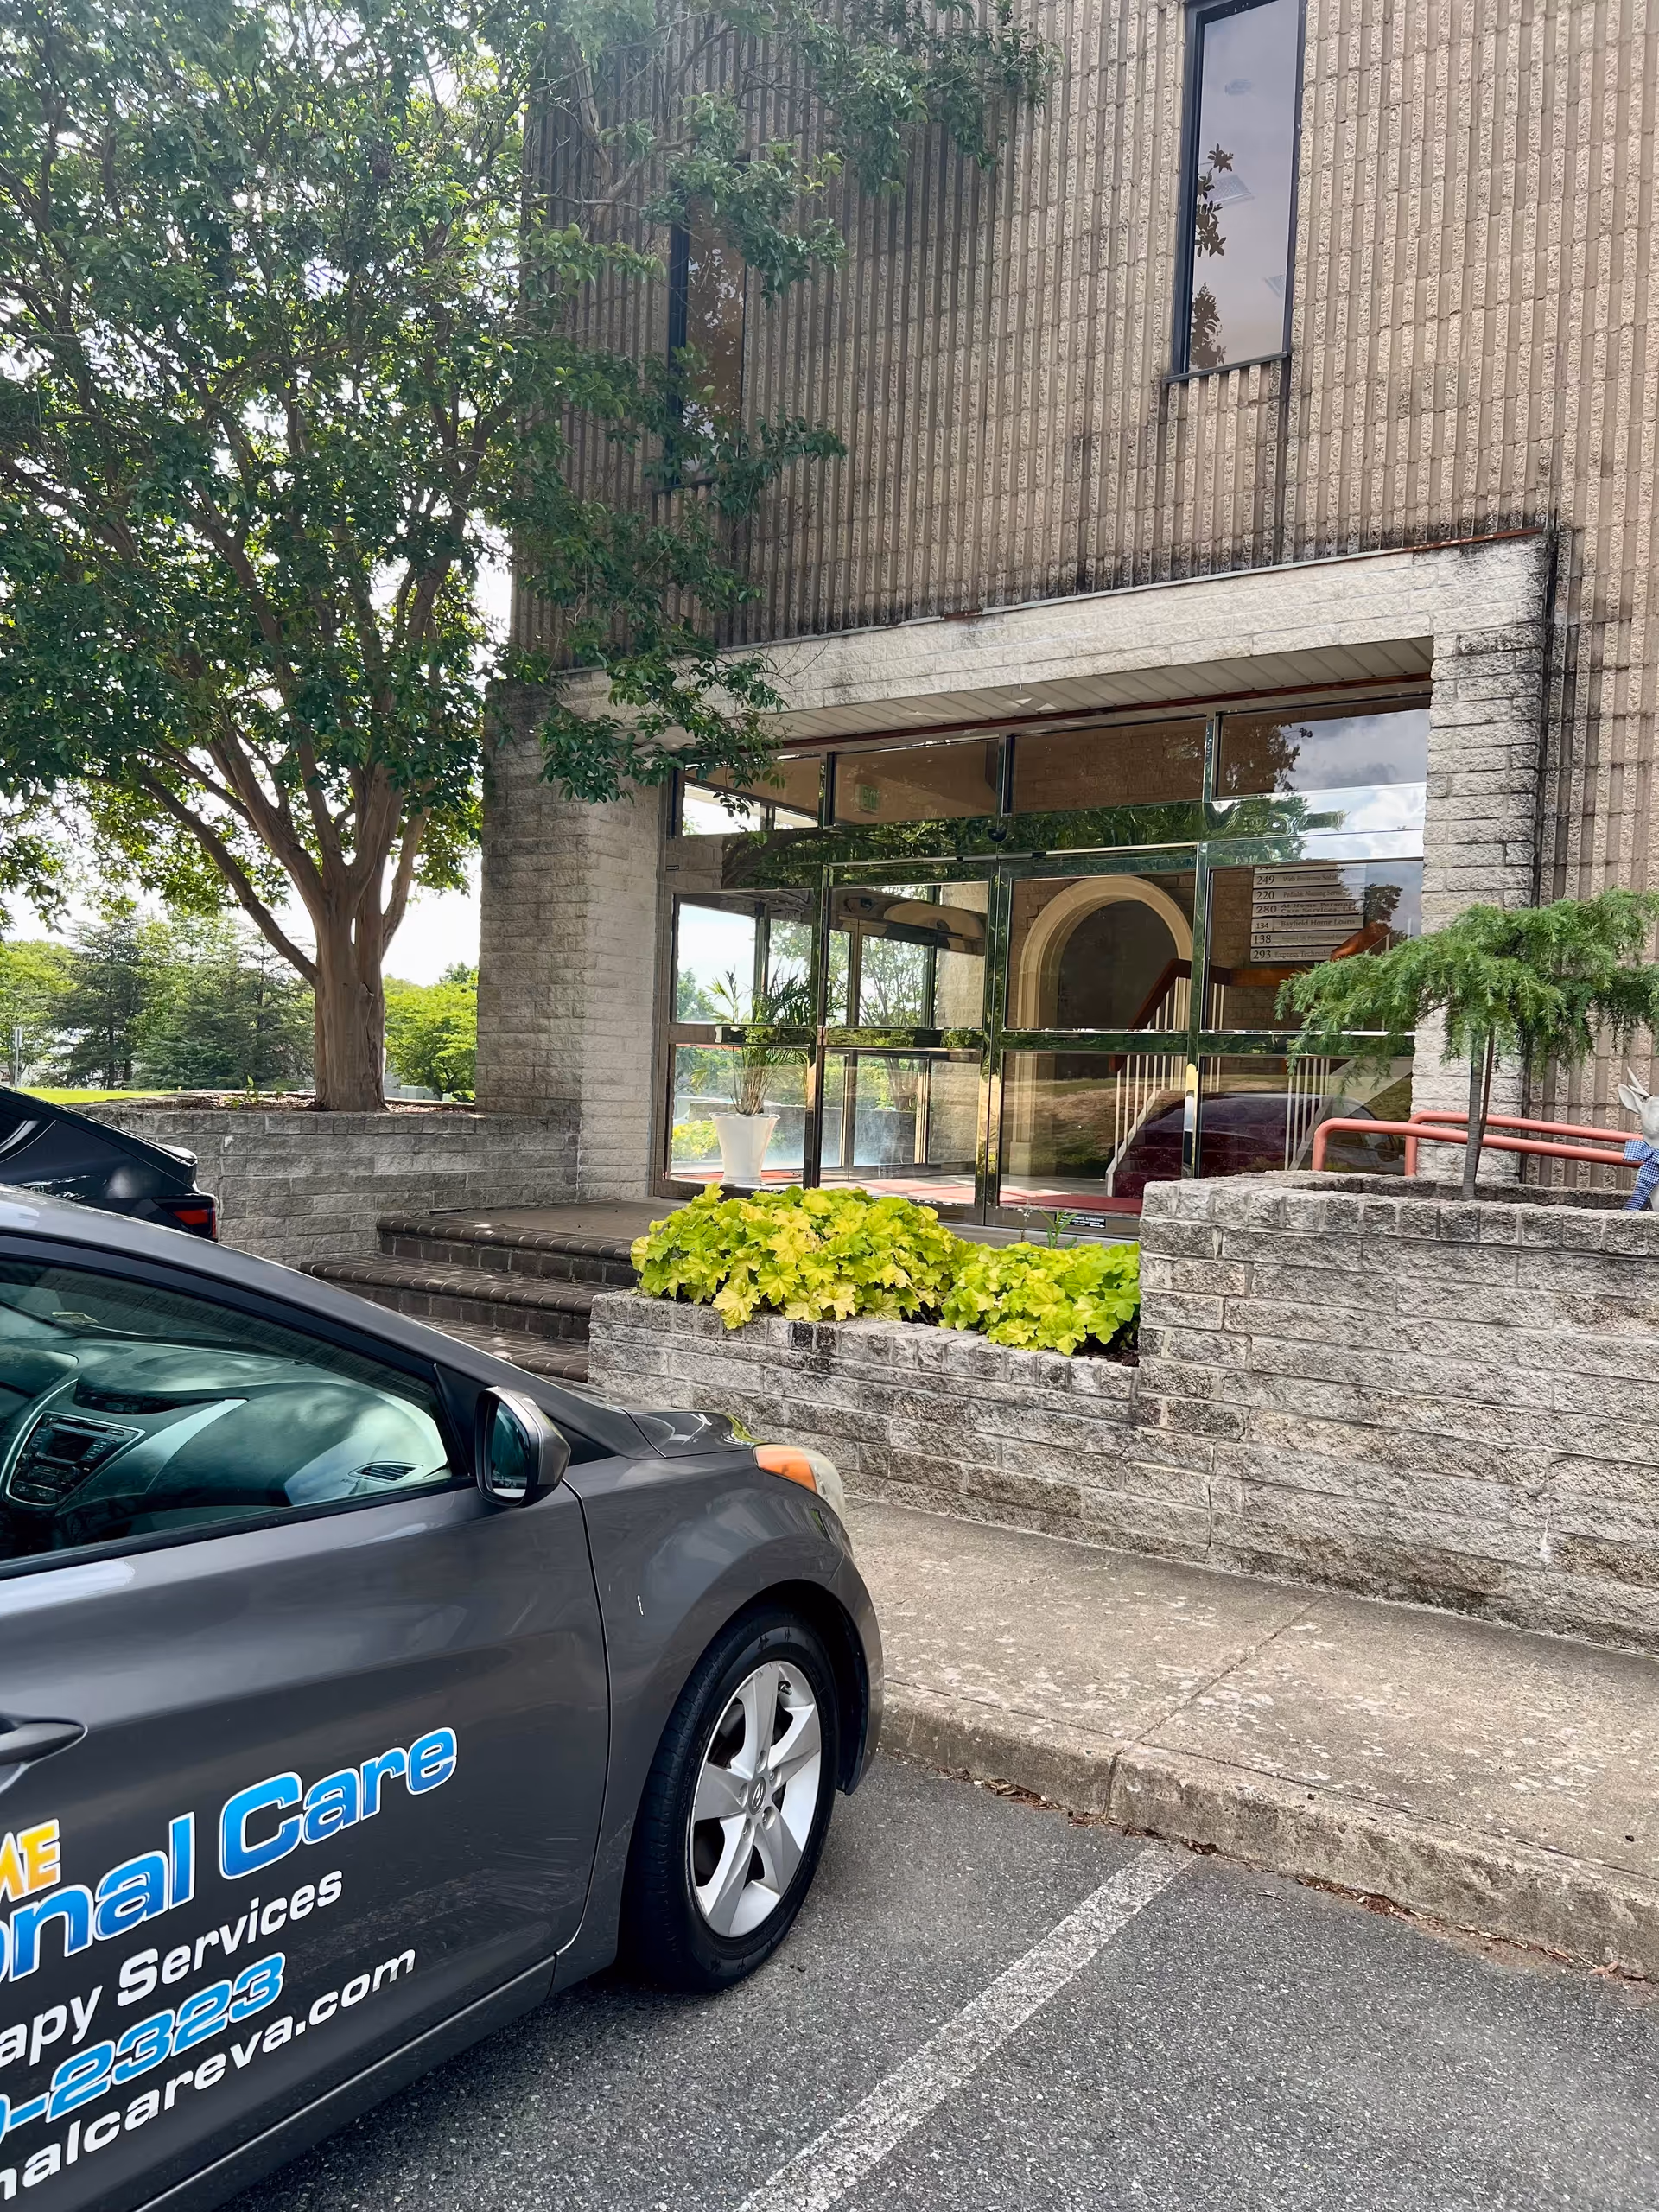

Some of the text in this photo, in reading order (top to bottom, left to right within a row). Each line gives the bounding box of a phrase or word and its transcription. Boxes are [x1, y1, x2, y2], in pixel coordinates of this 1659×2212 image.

[1256, 874, 1275, 885] 249
[1256, 891, 1275, 900] 220
[1255, 905, 1277, 914] 280
[1281, 920, 1309, 929] Bayfield
[1254, 934, 1272, 944] 138
[1253, 950, 1272, 960] 293
[0, 1727, 458, 1982] nal Care
[118, 1871, 343, 2006] Services
